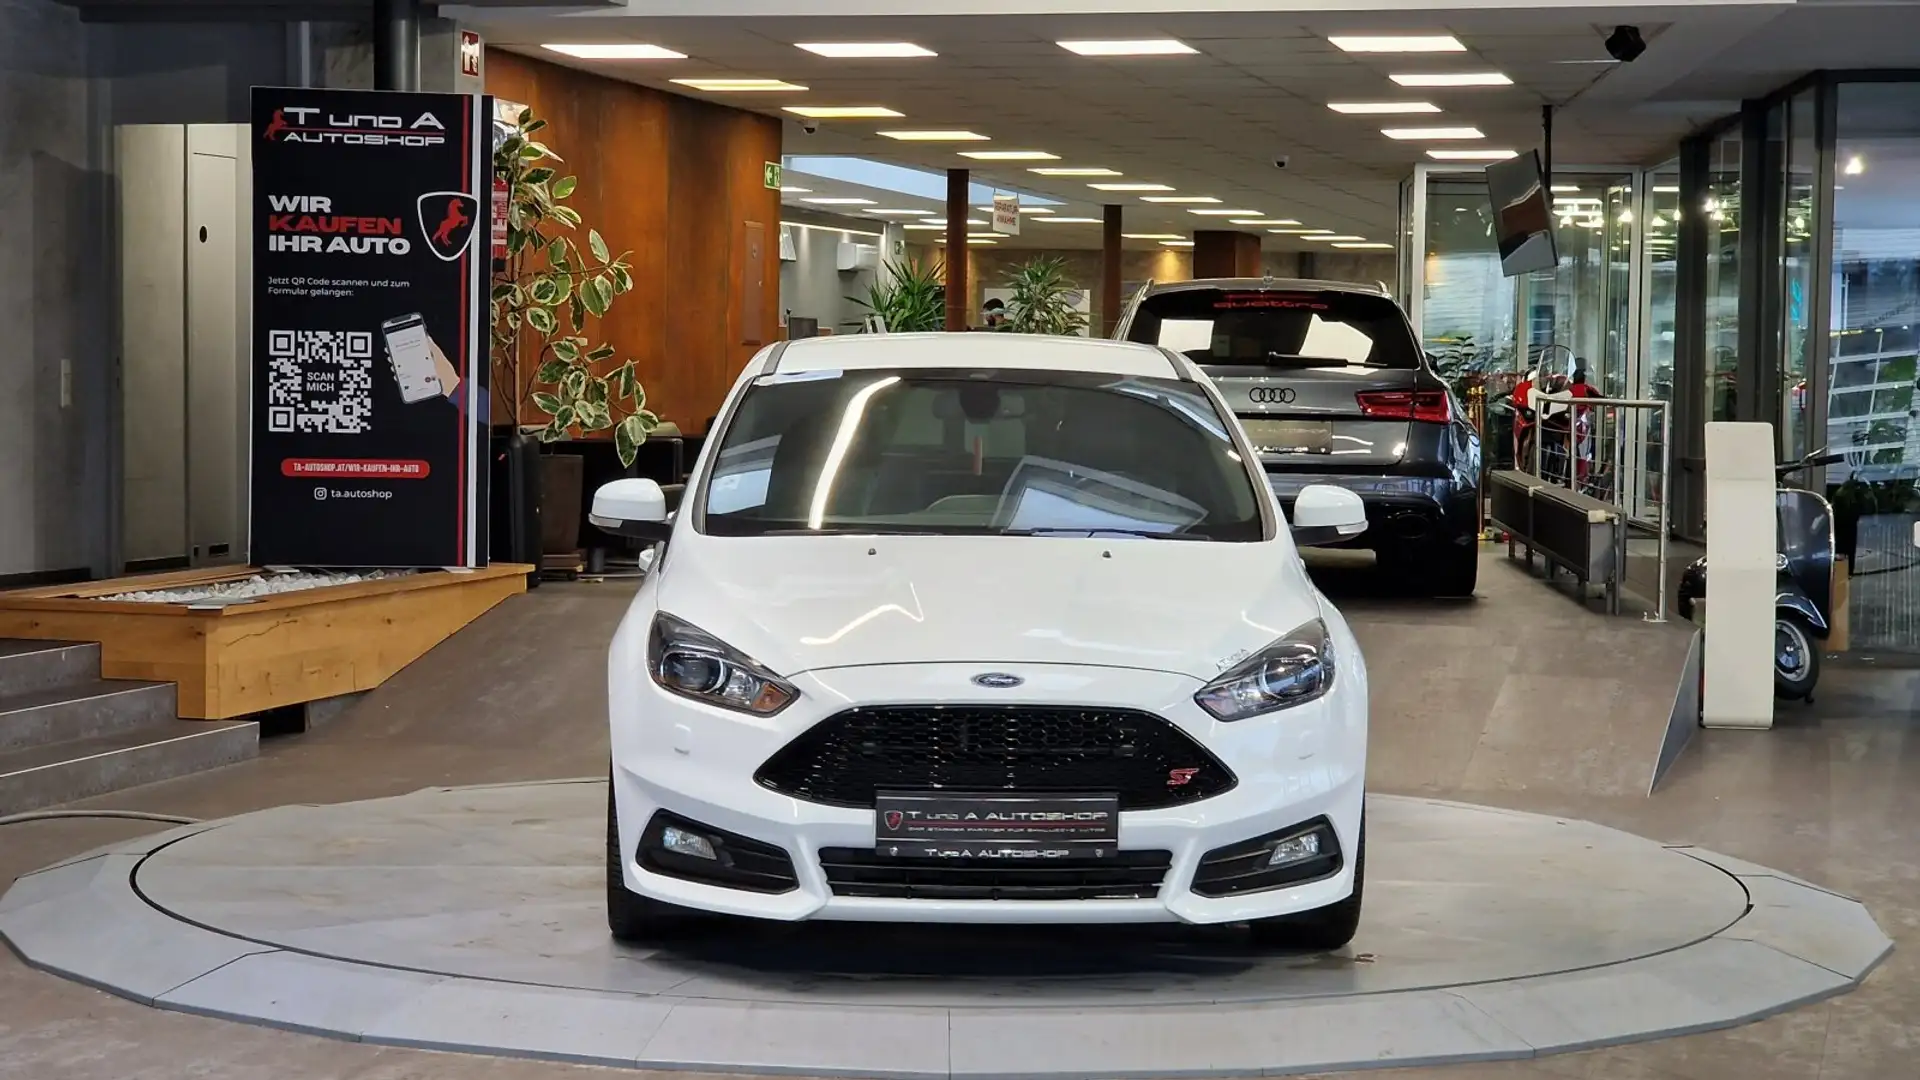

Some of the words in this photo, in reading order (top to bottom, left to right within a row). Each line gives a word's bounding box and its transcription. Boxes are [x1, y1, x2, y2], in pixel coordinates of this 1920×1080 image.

[283, 106, 321, 125] T
[410, 111, 446, 130] A
[283, 131, 446, 147] AUTOSHOP
[268, 195, 332, 214] WIR
[268, 215, 402, 235] KAUFEN
[268, 235, 325, 253] IHR
[325, 237, 412, 256] AUTO
[267, 276, 290, 286] Jetzt
[291, 277, 306, 287] QR
[307, 277, 331, 287] Code
[331, 279, 369, 288] scannen
[371, 278, 389, 288] und
[390, 280, 411, 289] zum
[267, 286, 309, 297] Formular
[310, 288, 355, 299] gelangen:
[1213, 300, 1329, 310] quattro
[306, 372, 335, 382] SCAN
[306, 382, 335, 392] MICH
[330, 488, 393, 500] ta.autoshop
[906, 811, 922, 820] T
[965, 811, 979, 821] A
[985, 811, 1109, 821] AUTOSHOP
[977, 848, 1070, 858] AUTOSHOP
